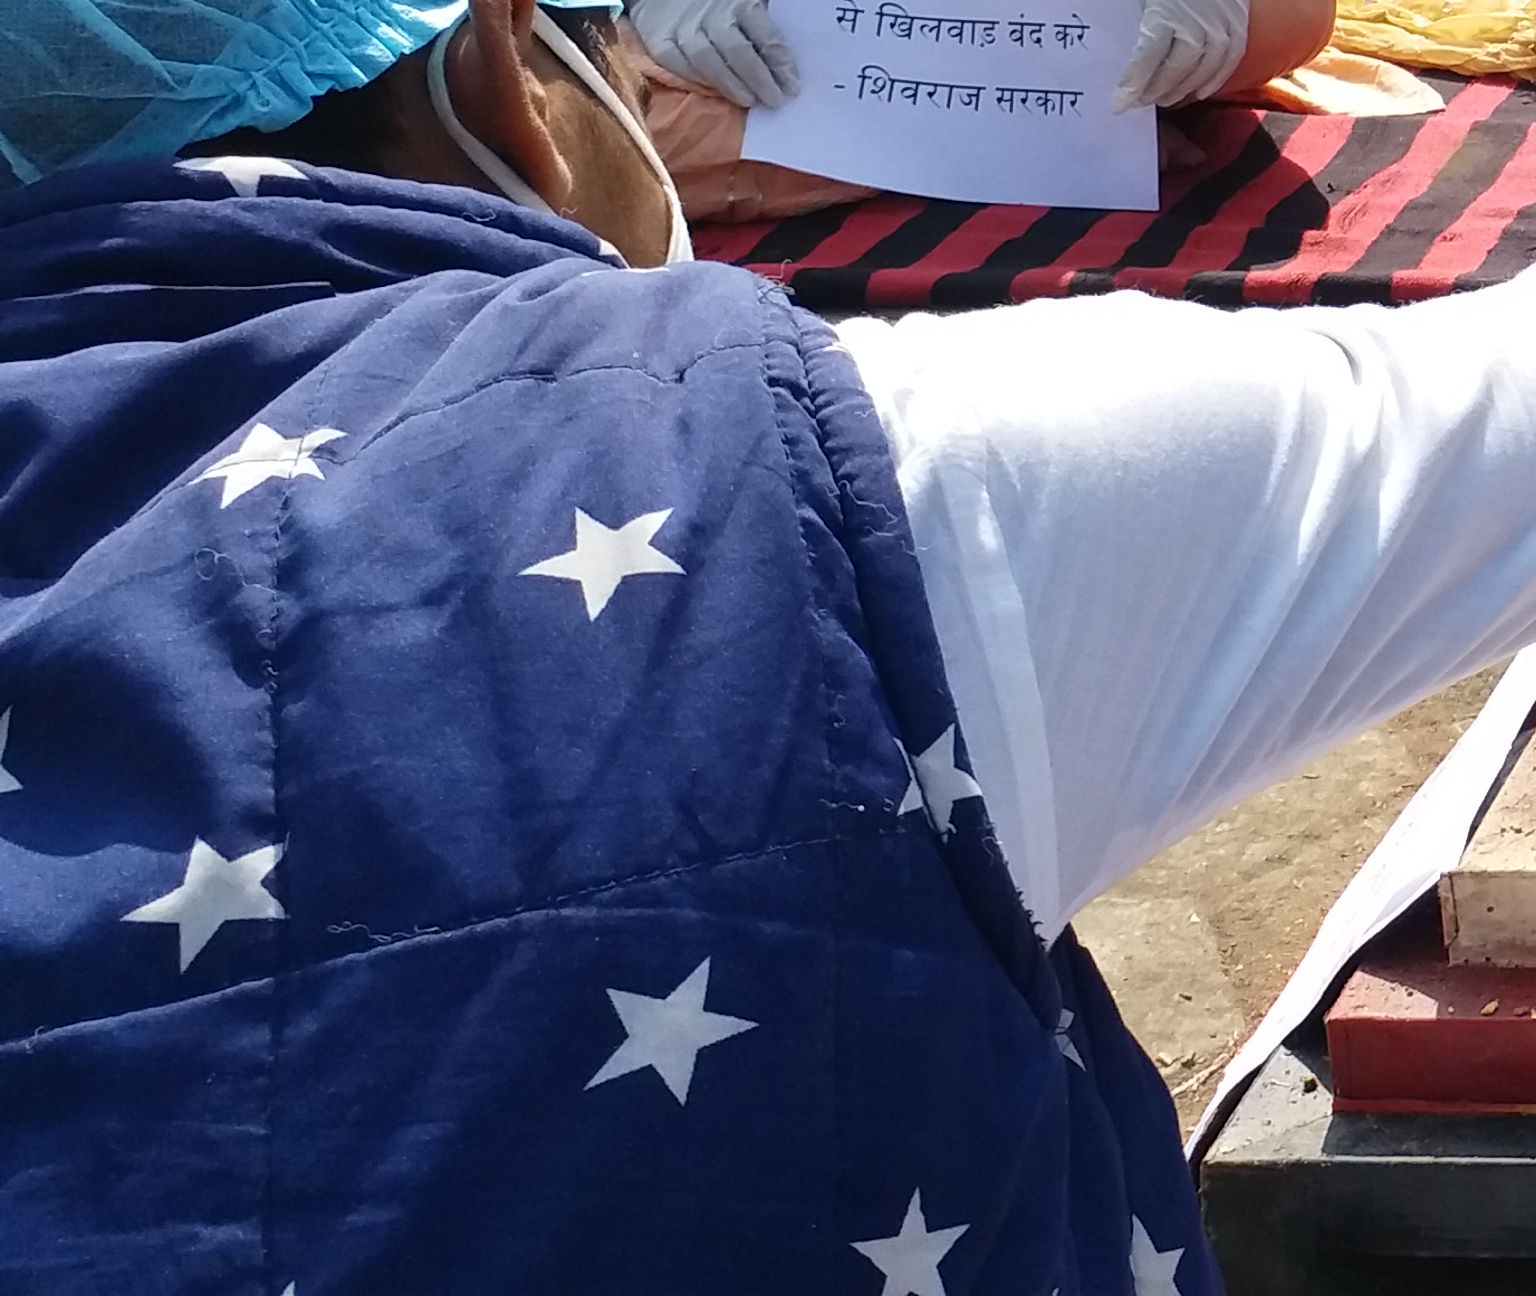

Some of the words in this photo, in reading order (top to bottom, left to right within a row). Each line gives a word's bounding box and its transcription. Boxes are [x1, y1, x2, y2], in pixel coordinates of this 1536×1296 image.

[875, 2, 1000, 48] खिलवाड़
[1054, 13, 1090, 50] करे
[857, 65, 987, 112] शिवराज
[995, 87, 1084, 116] सरकार
